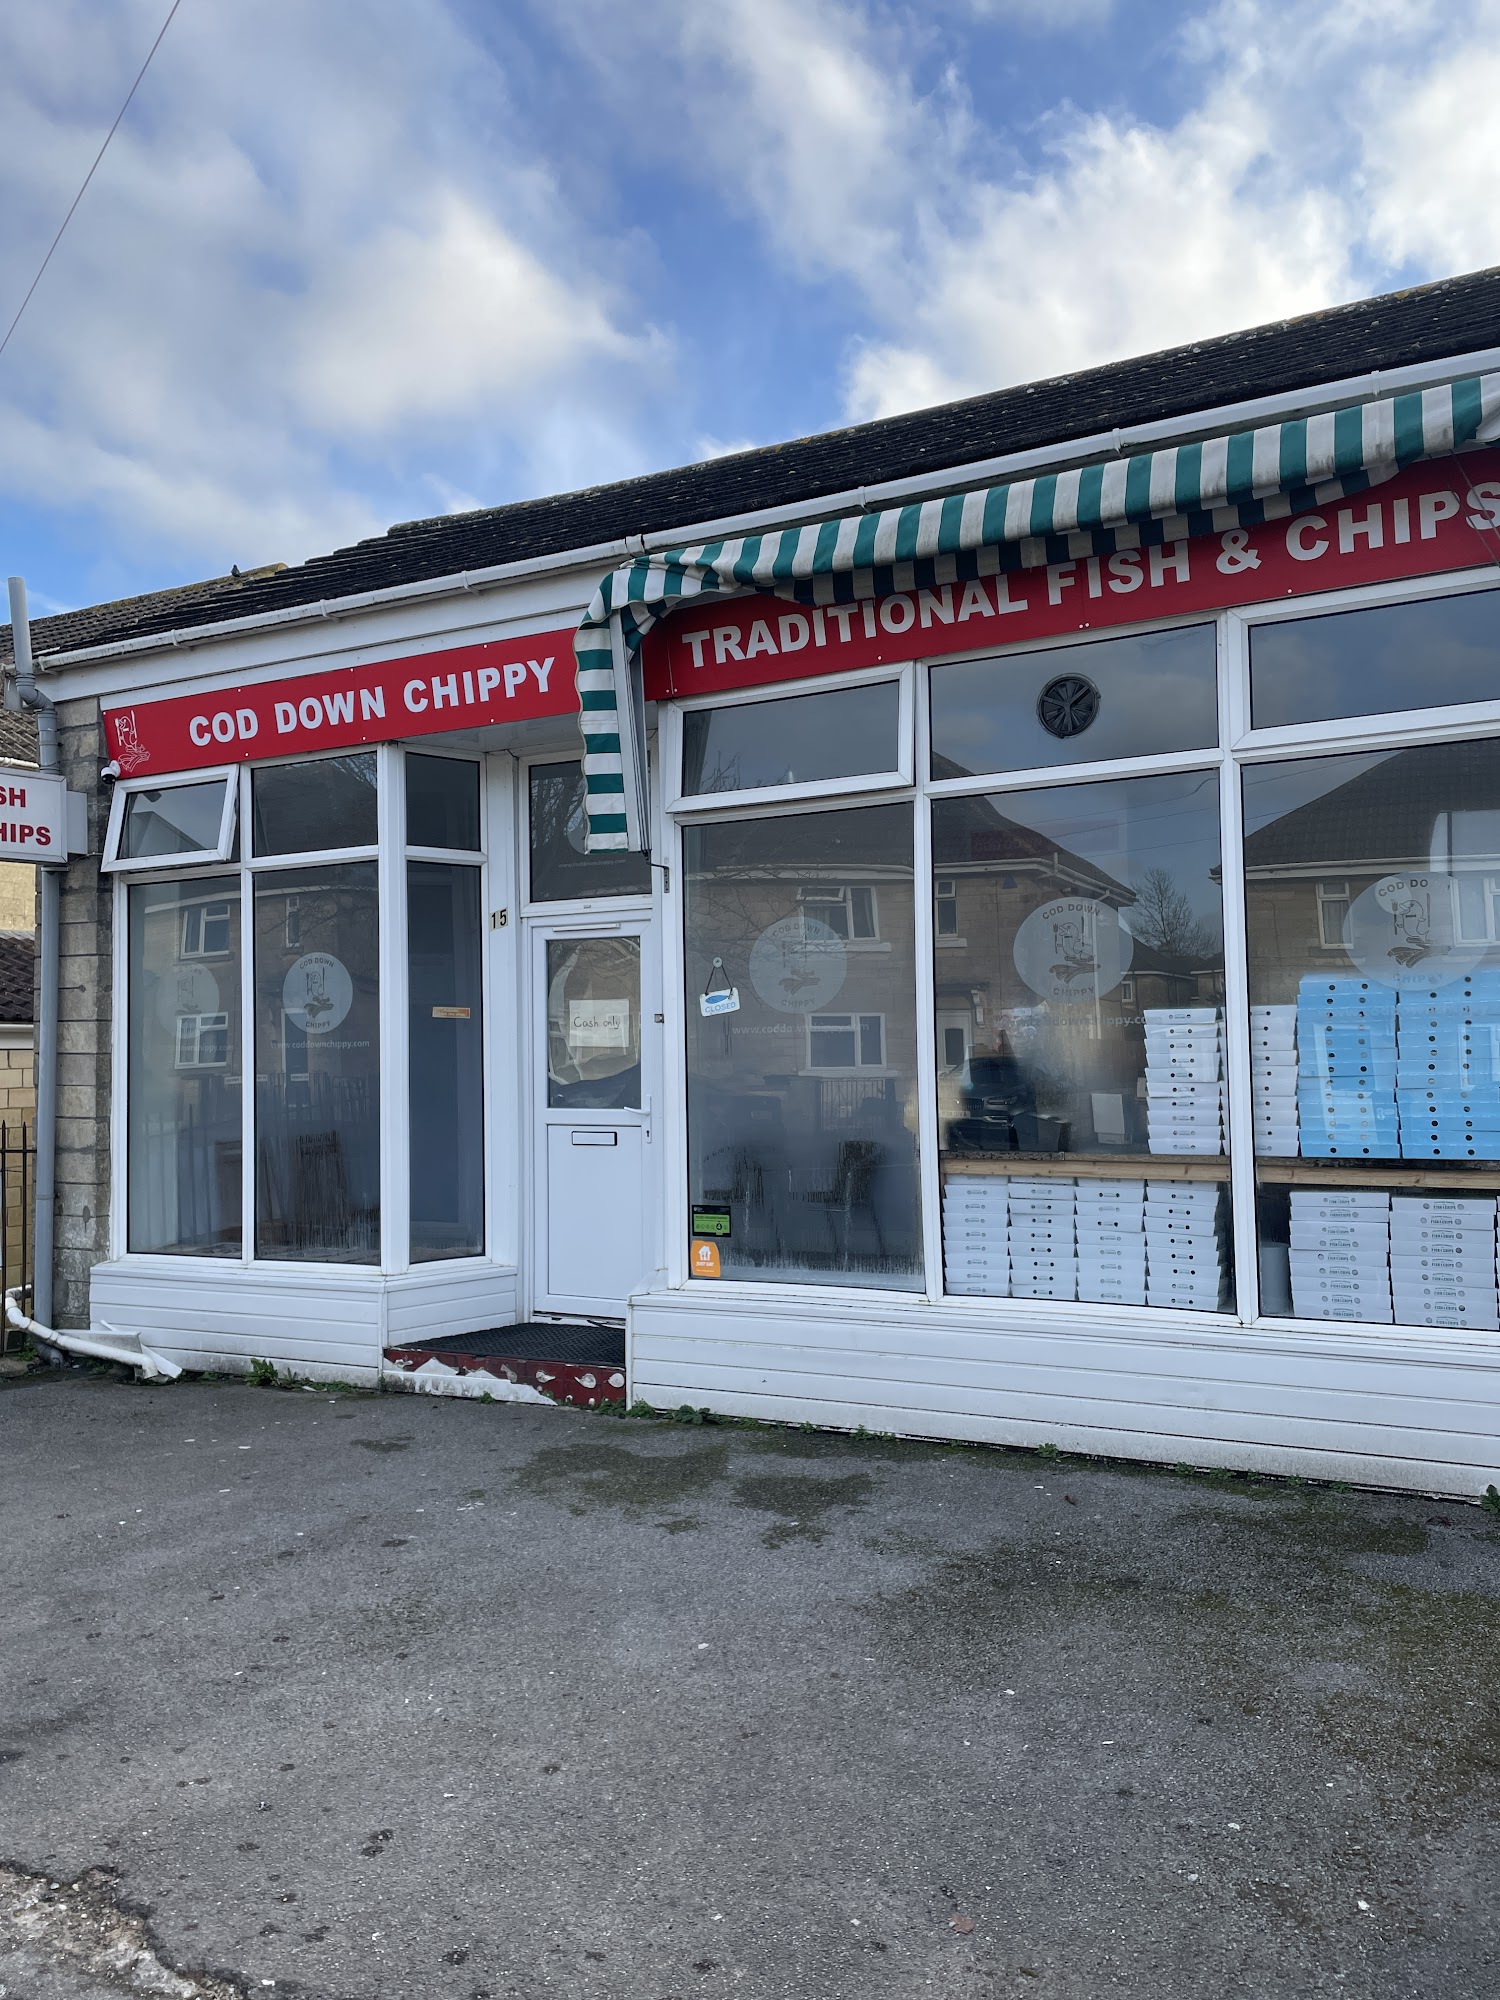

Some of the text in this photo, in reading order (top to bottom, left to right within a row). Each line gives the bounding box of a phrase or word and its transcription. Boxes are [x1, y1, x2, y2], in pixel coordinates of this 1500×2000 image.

[682, 482, 1500, 668] TRADITIONAL FISH & CHIPS
[189, 657, 555, 747] COD DOWN CHIPPY
[1378, 881, 1405, 897] COD
[491, 909, 507, 929] 15
[1042, 903, 1101, 920] COD DOWN
[772, 923, 821, 938] COD DOWN
[299, 957, 335, 969] COD DOWN
[1393, 973, 1442, 984] CHIP
[1053, 986, 1095, 997] CHIPPY
[704, 1001, 736, 1014] CLOSED
[781, 997, 815, 1008] CHIPPY
[305, 1021, 331, 1029] CHIPPY
[573, 1015, 621, 1030] Cash only
